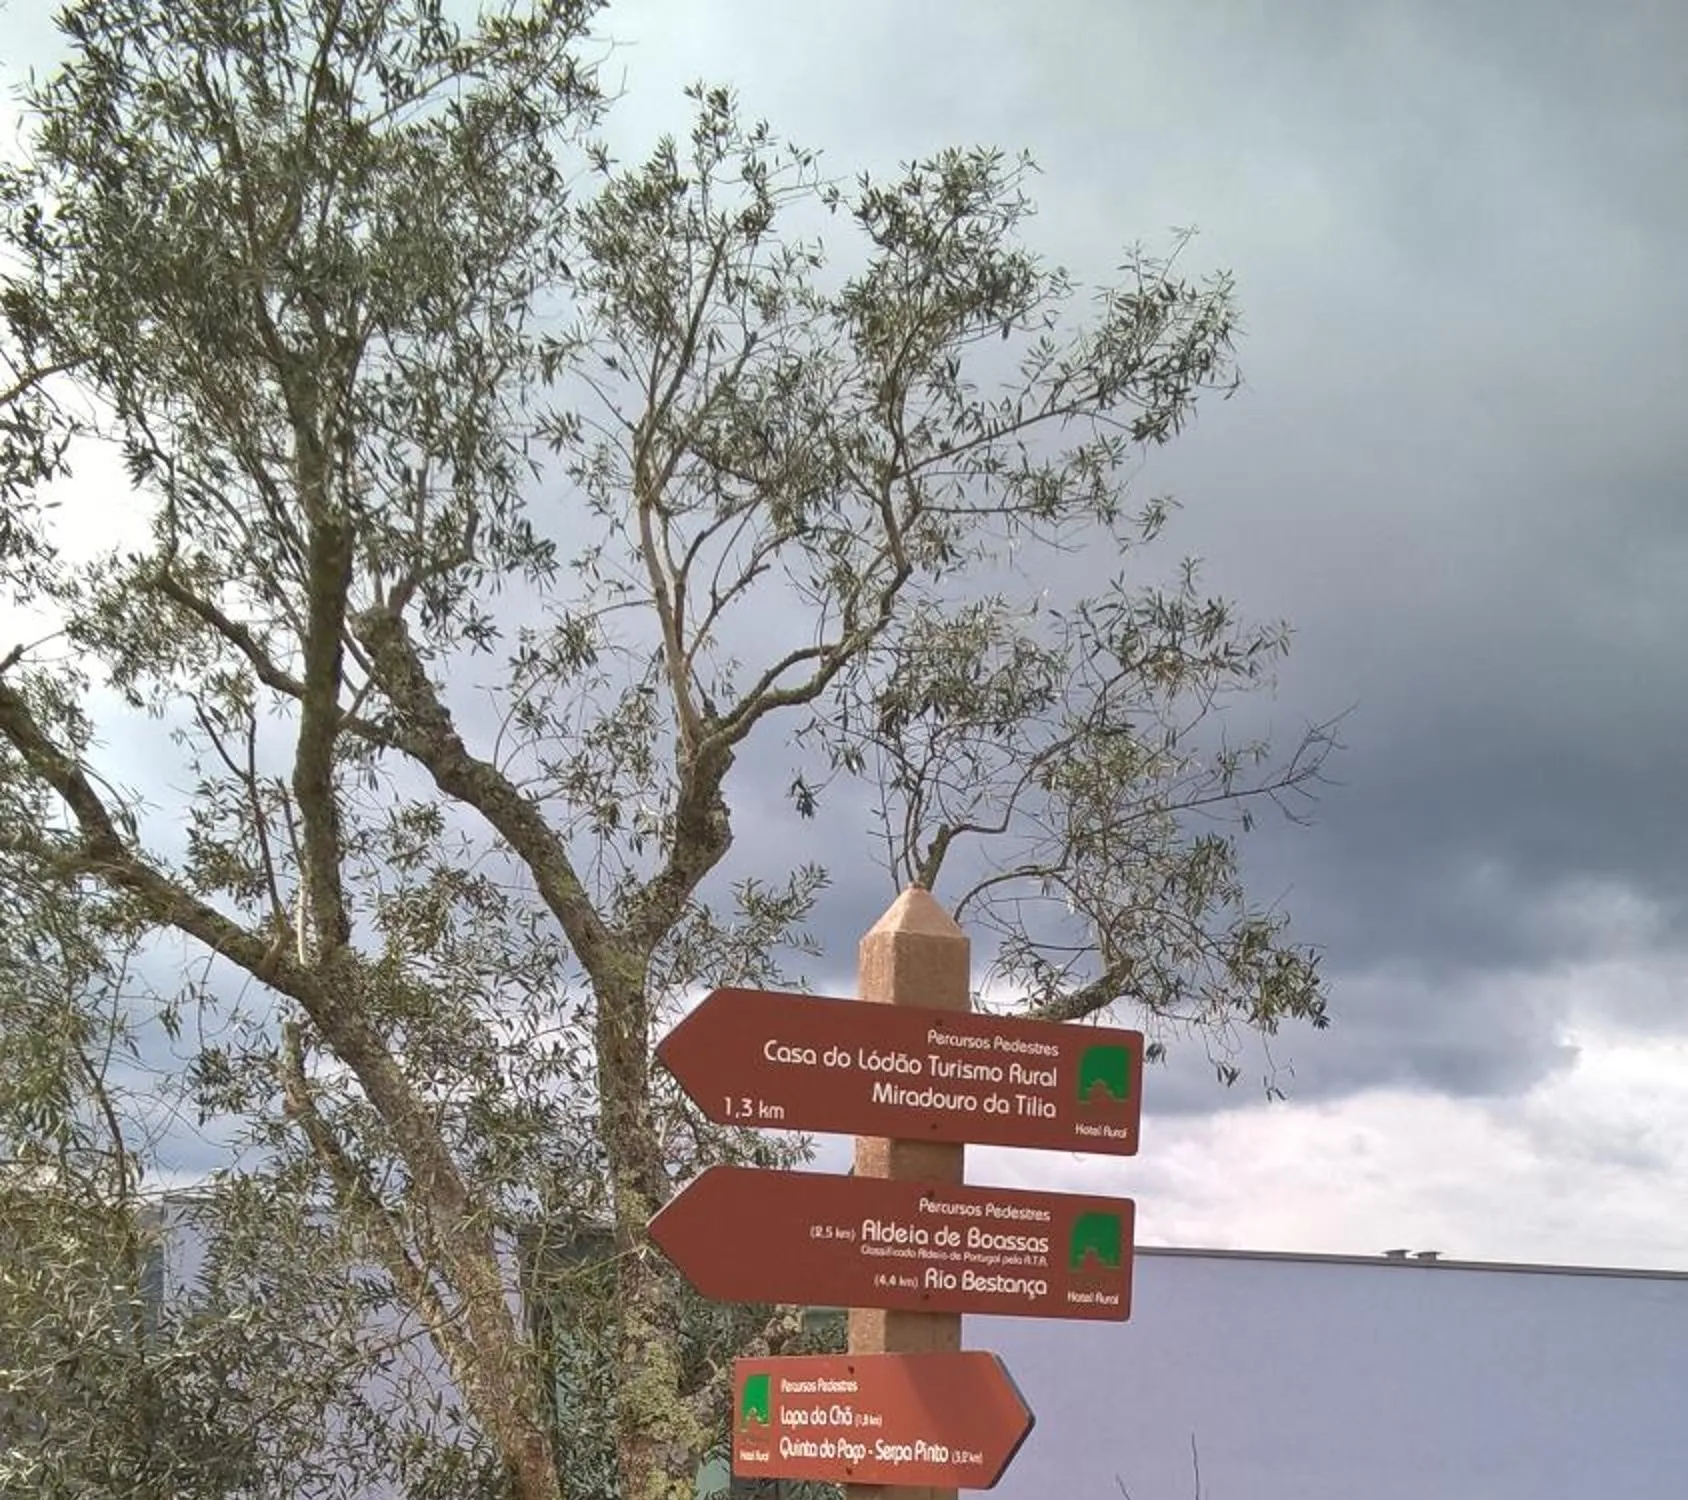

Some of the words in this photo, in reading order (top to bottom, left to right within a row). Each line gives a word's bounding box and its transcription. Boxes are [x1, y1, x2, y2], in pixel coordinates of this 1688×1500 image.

[927, 1029, 991, 1050] Percursos
[994, 1036, 1060, 1057] Pedestres
[764, 1039, 817, 1066] Casa
[823, 1047, 851, 1068] do
[859, 1048, 922, 1075] Lódão
[928, 1054, 1002, 1083] Turismo
[1009, 1062, 1057, 1087] Rural
[722, 1096, 753, 1120] 1,3
[758, 1099, 785, 1120] km
[872, 1082, 976, 1112] Miradouro
[983, 1092, 1009, 1115] da
[1075, 1123, 1101, 1137] Hotel
[1103, 1124, 1128, 1139] Rural
[919, 1197, 983, 1217] Percursos
[986, 1202, 1050, 1221] Pedestres
[861, 1219, 929, 1246] Aldeia
[934, 1225, 961, 1247] de
[967, 1227, 1049, 1253] Boassas
[898, 1275, 919, 1290] km)
[924, 1267, 957, 1290] Rio
[961, 1269, 1048, 1300] Bestança
[1067, 1290, 1094, 1304] Hotel
[1095, 1293, 1119, 1305] Rural
[780, 1377, 817, 1393] Percursos
[817, 1377, 859, 1393] Pedestres
[780, 1405, 809, 1429] Lapa
[810, 1405, 828, 1425] da
[779, 1436, 818, 1459] Quinta
[819, 1438, 837, 1459] do
[838, 1437, 866, 1464] Paço
[875, 1438, 913, 1465] Serpa
[914, 1439, 949, 1463] Pinto
